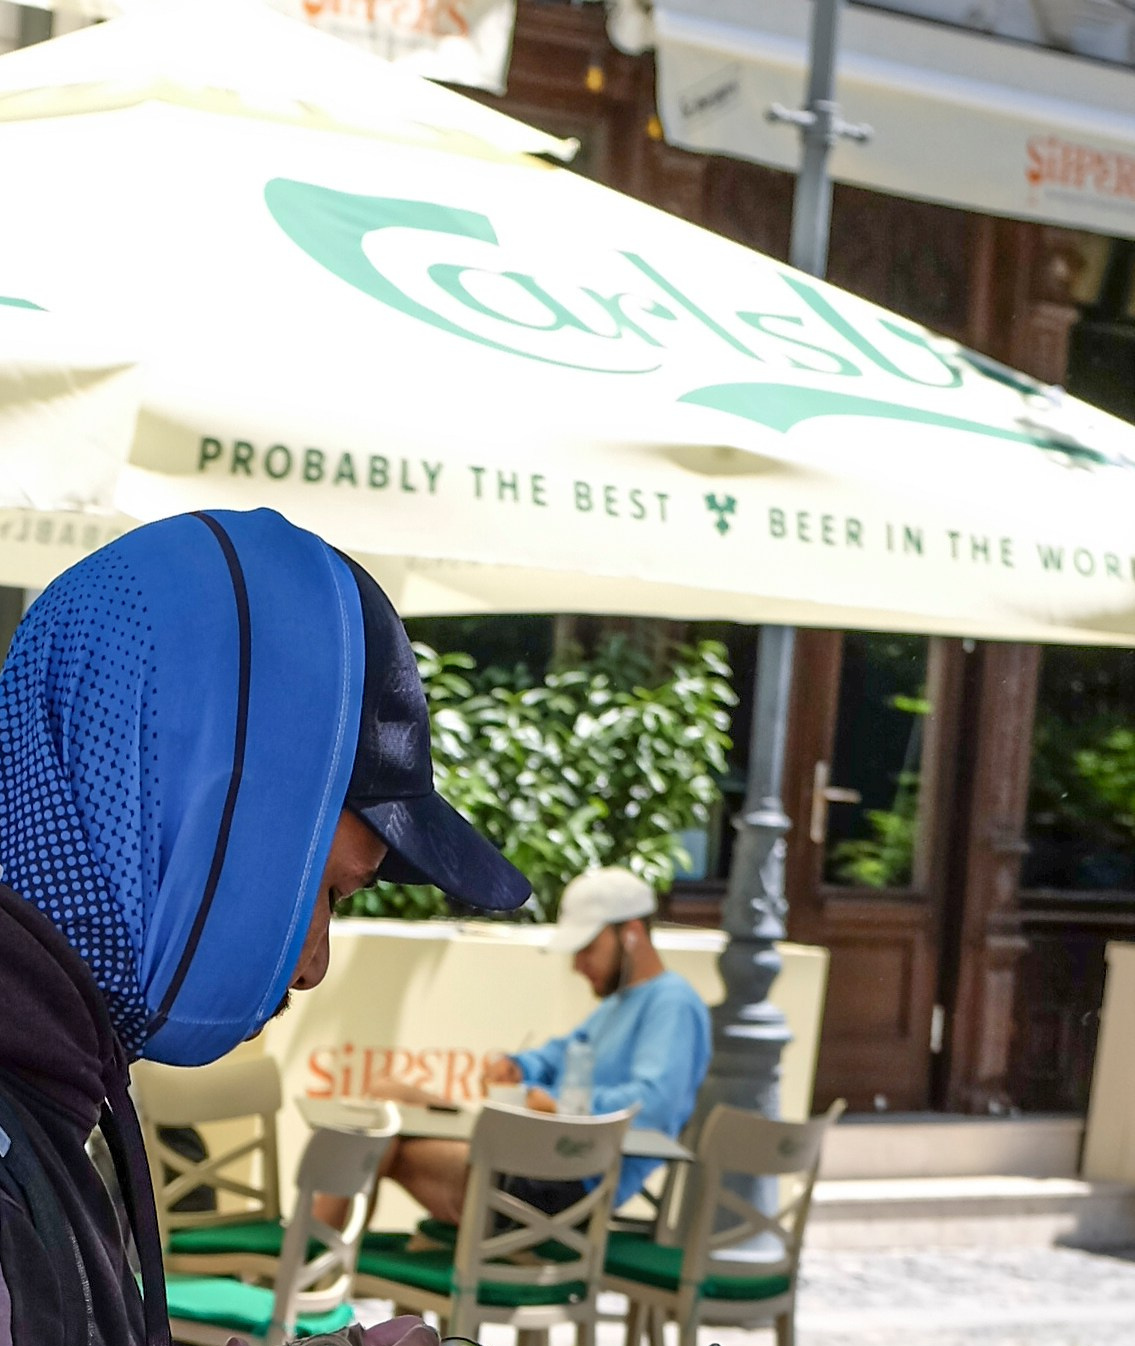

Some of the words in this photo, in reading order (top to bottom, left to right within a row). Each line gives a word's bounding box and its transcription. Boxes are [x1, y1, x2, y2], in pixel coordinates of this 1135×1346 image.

[198, 436, 444, 495] PROBABLY
[469, 464, 548, 507] THE
[573, 480, 670, 523] BEST
[768, 506, 864, 548] BEER
[885, 521, 925, 557] IN
[945, 528, 1014, 568] THE
[1036, 542, 1135, 584] WOR
